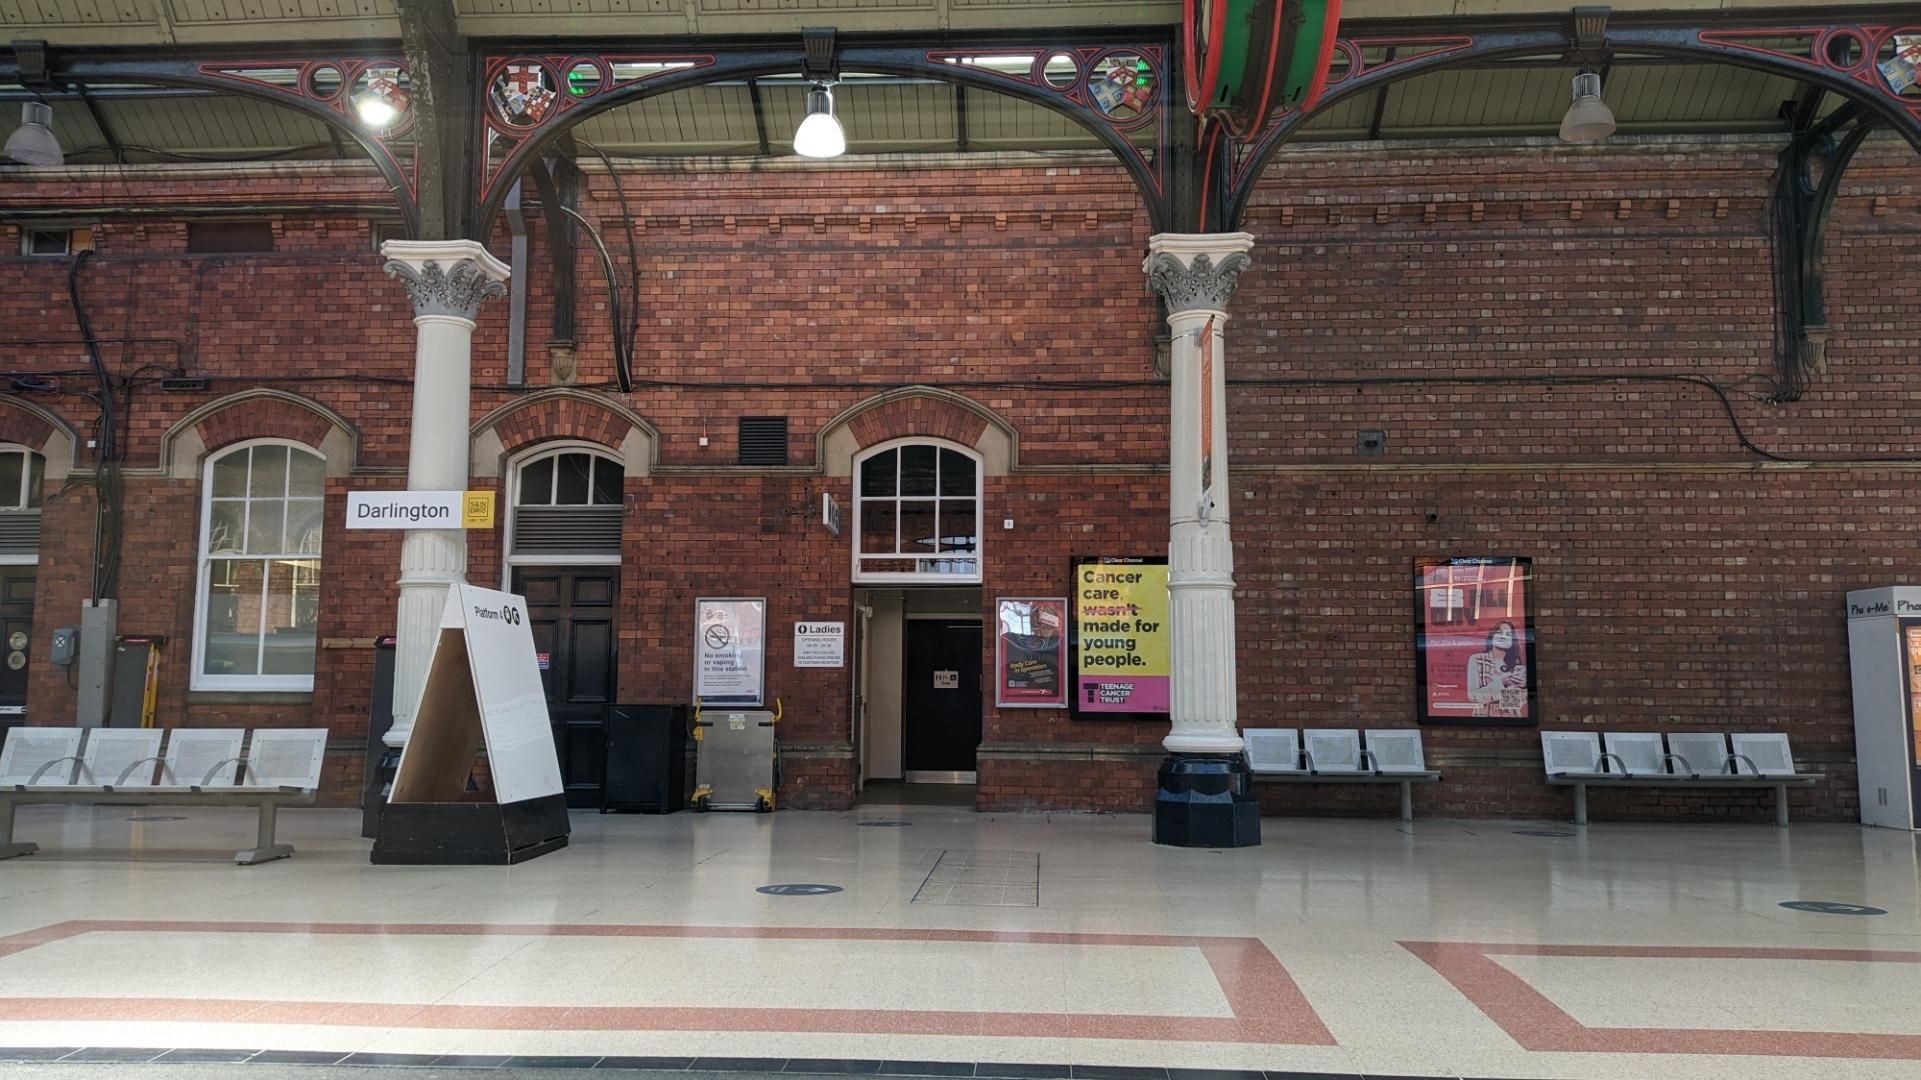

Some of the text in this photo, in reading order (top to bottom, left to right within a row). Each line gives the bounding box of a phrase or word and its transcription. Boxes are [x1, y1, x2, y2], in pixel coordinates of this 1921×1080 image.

[357, 502, 449, 522] Darlington
[1083, 570, 1142, 584] Cancer
[474, 605, 499, 620] Platform
[1083, 603, 1139, 616] wasn't
[809, 624, 841, 634] Ladies
[1083, 619, 1160, 632] made for
[1083, 638, 1137, 652] young
[1083, 652, 1147, 668] people.
